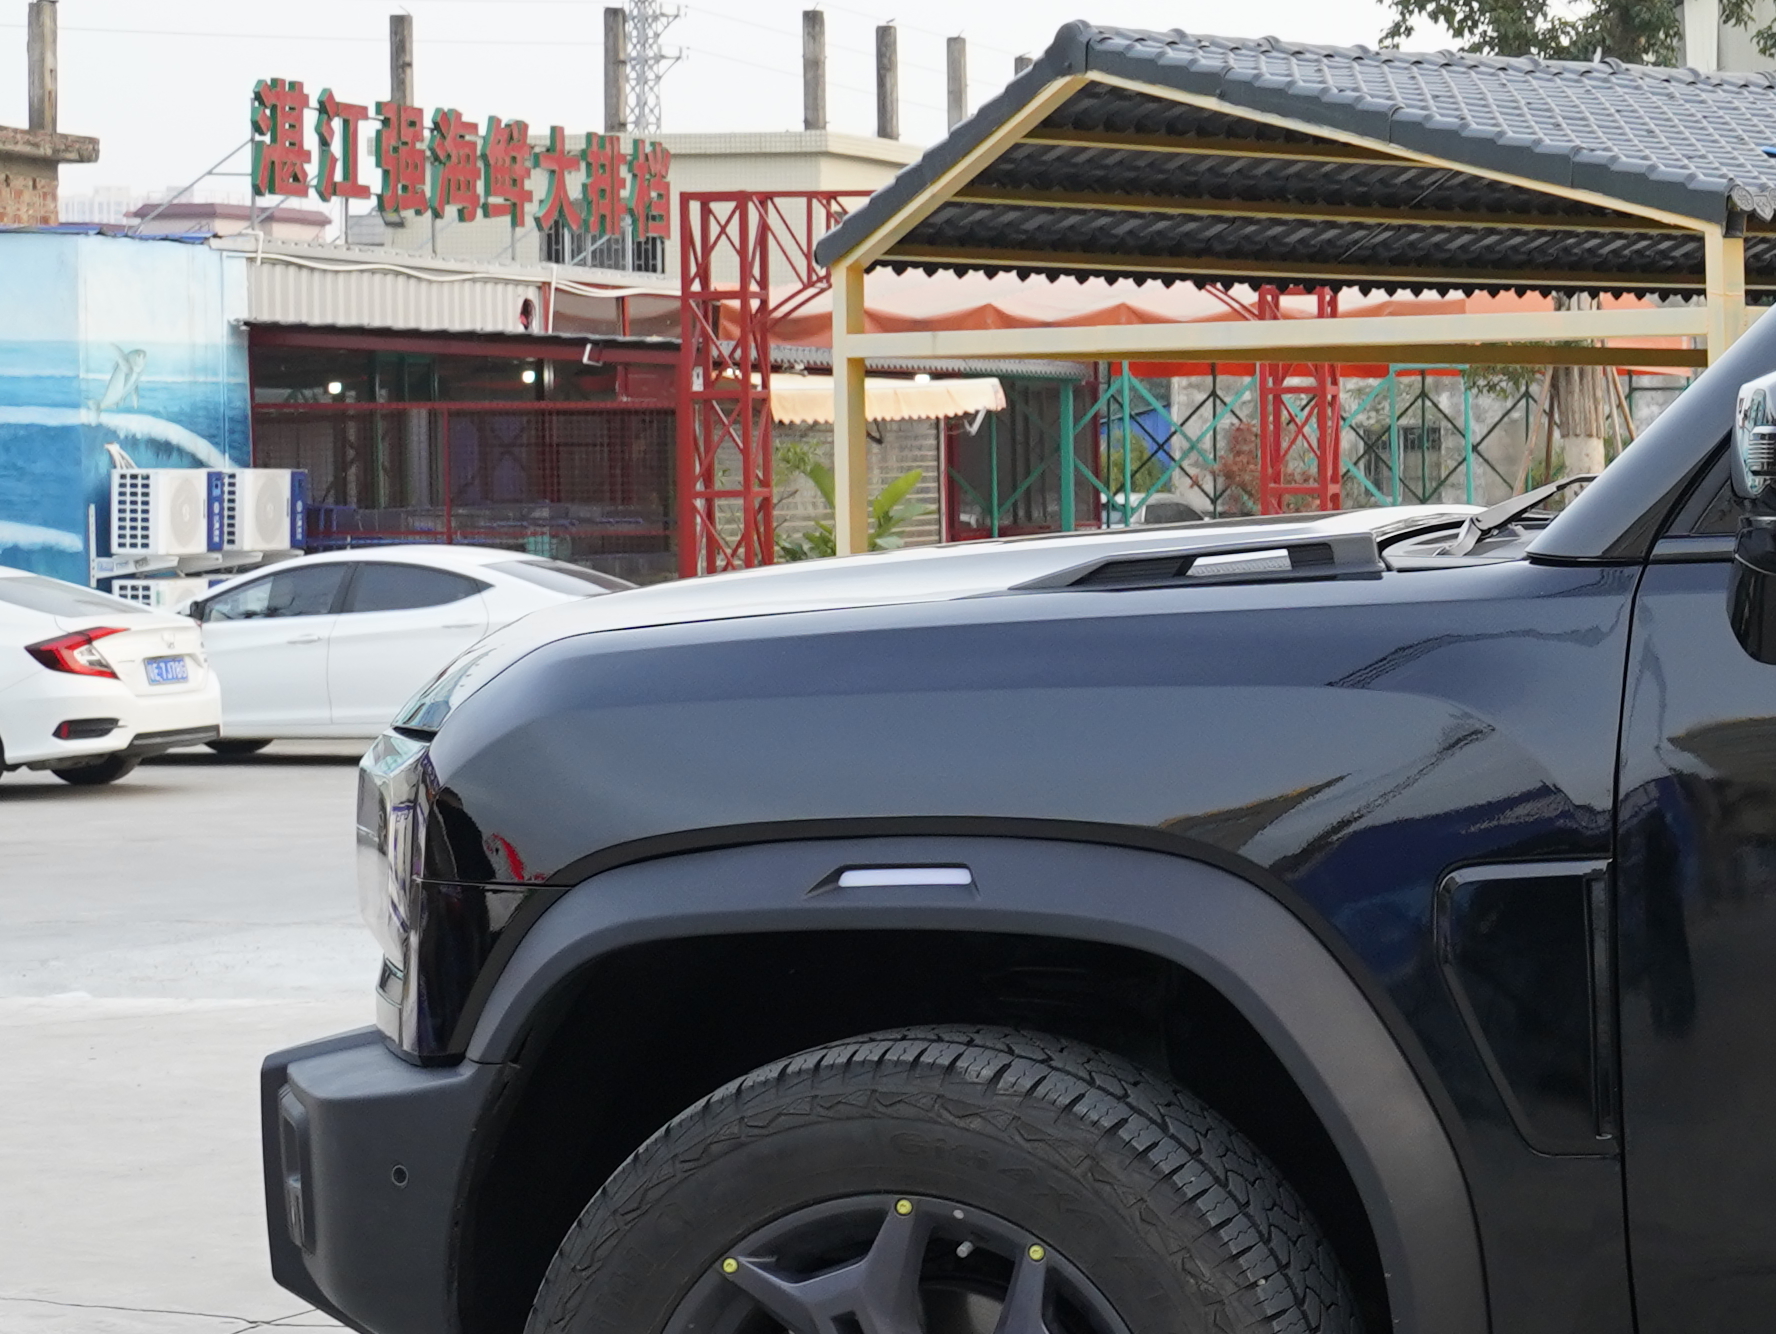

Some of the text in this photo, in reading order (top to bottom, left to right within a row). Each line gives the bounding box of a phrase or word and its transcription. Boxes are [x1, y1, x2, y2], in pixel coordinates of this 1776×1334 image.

[250, 77, 673, 242] 湛江强海鲜大排档
